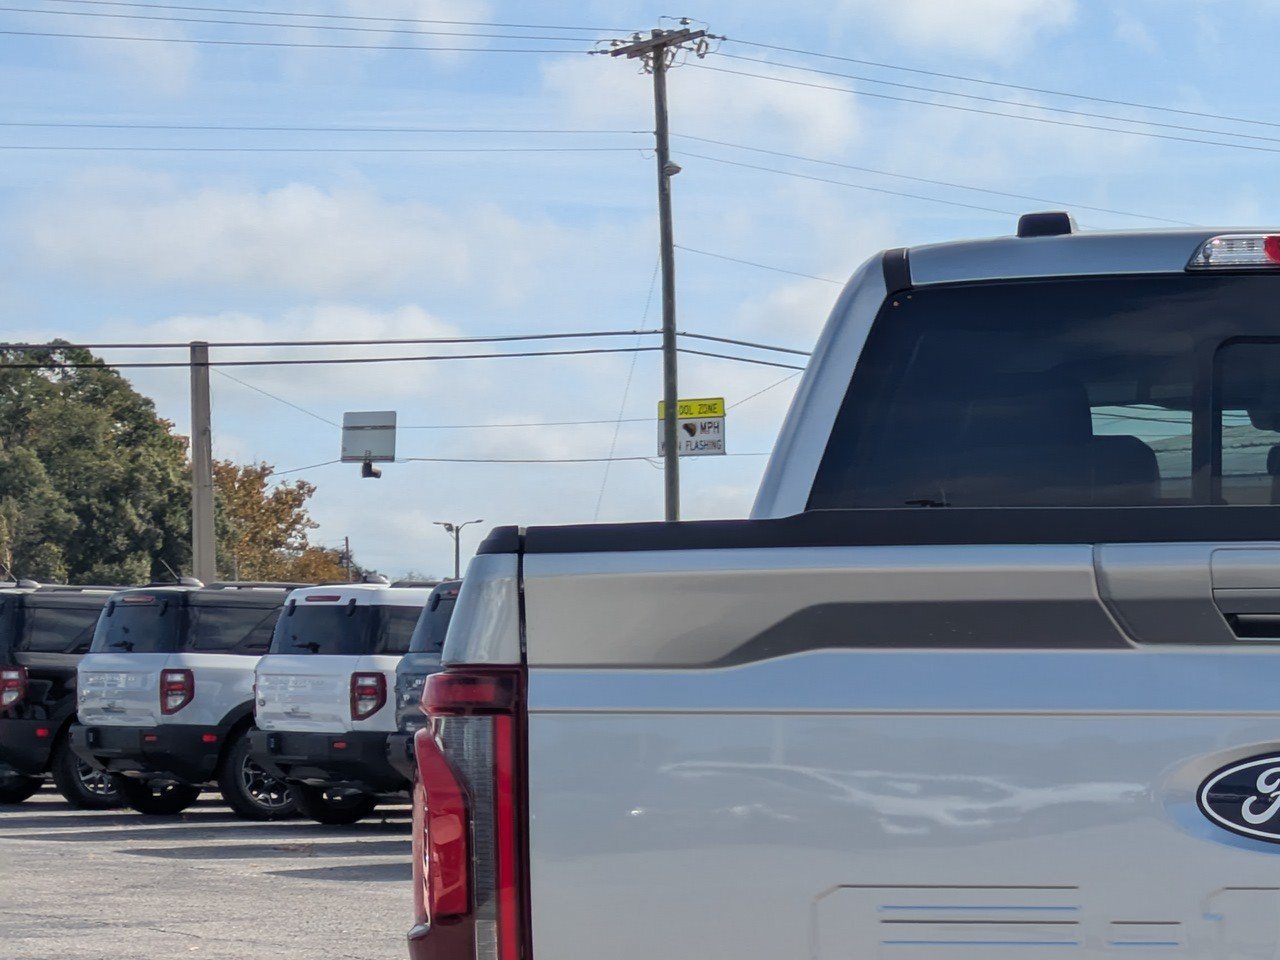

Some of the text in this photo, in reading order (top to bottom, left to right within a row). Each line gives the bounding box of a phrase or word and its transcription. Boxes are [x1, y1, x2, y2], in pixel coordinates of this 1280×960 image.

[698, 403, 718, 414] ZONE
[700, 422, 720, 434] MPH
[685, 440, 721, 451] FLASHING
